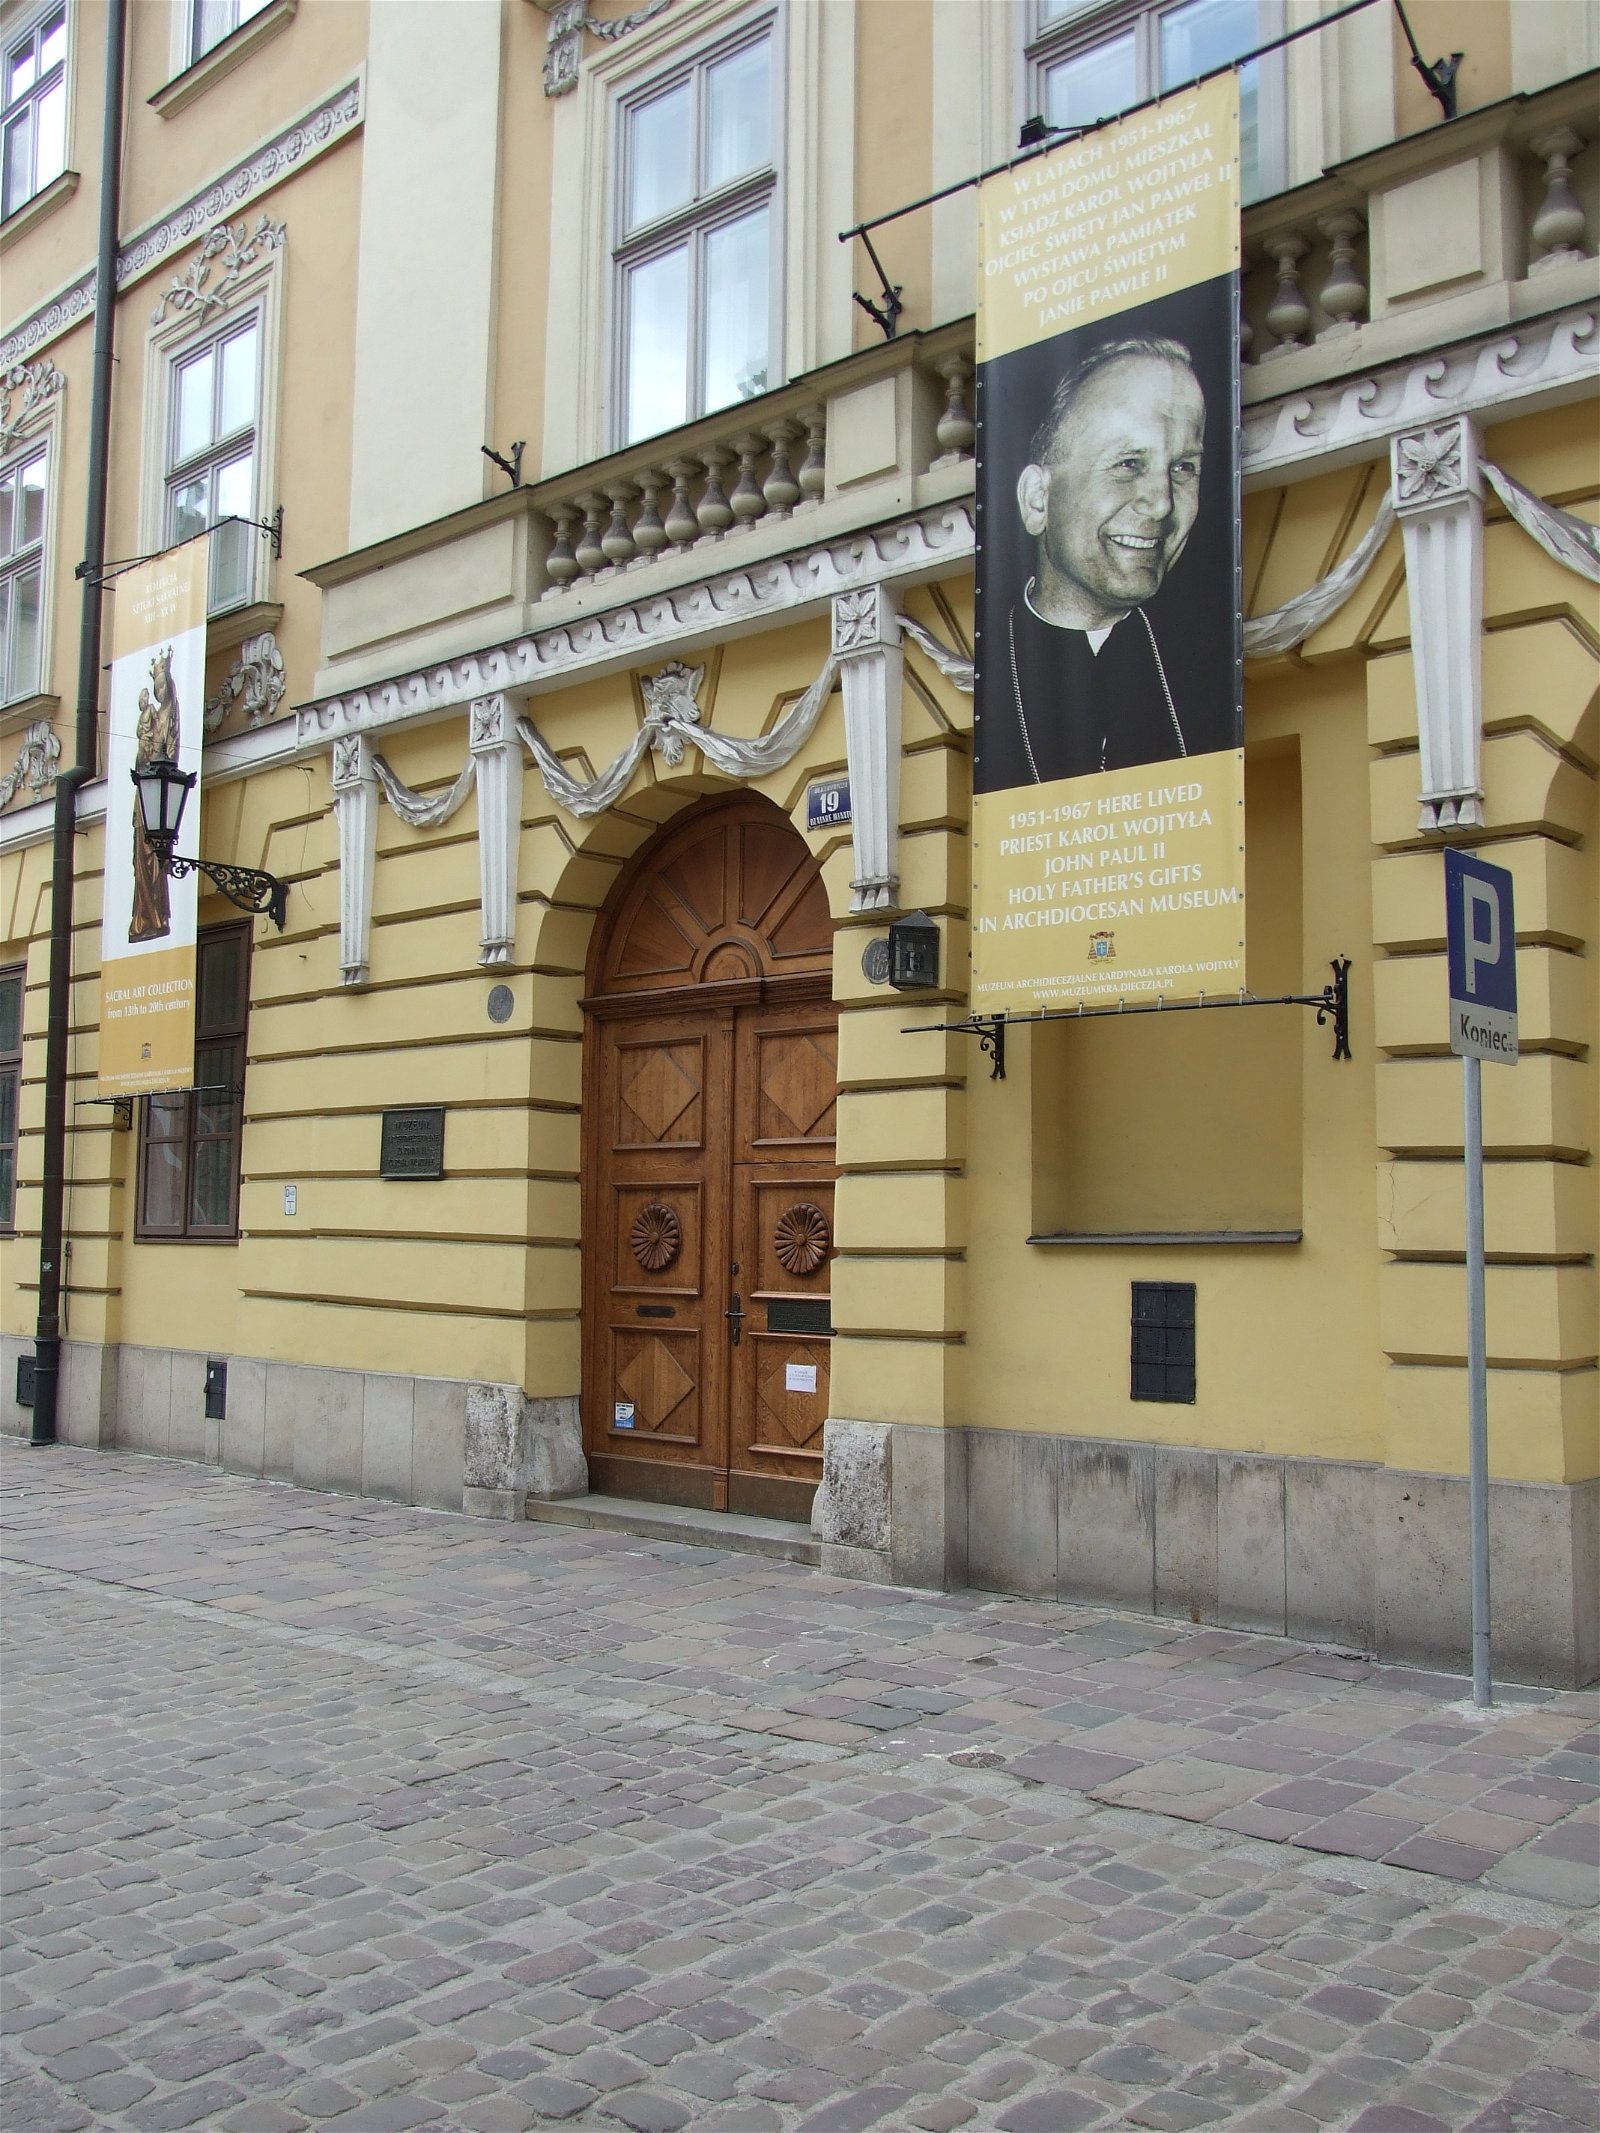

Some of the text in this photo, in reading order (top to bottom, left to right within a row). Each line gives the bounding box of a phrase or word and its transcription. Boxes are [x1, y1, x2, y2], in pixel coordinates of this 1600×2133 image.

[999, 121, 1214, 224] W TYM DOMU MIESZKAŁ
[1014, 103, 1198, 195] W LATACH 1951-1967
[985, 165, 1233, 277] OJCIEC ŚWIĘTY JAN PAWEŁ II
[1000, 149, 1214, 247] KSIĄDZ KAROL WOJTYŁA
[1014, 203, 1197, 287] WYSTAWA PAMIĄTEK
[1023, 232, 1186, 308] PO OJCU ŚWIĘTYM
[1039, 264, 1168, 328] JANIE PAWLE II
[820, 791, 839, 814] 19
[1009, 783, 1202, 830] 1951-1967 HERE LIVED
[1000, 809, 1212, 856] PRIEST KAROL WOJTYŁA
[1044, 842, 1165, 878] JOHN PAUL II
[1009, 863, 1201, 905] HOLY FATHER'S GIFTS
[979, 887, 1238, 933] IN ARCHDIOCESAN MUSEUM
[1463, 873, 1501, 995] P
[105, 979, 193, 1002] SACRAL ART COLLECTION
[977, 981, 1014, 992] MUZEUM
[1016, 973, 1097, 989] ARCHIDIECEZJALNE
[1156, 964, 1193, 976] KAROLA
[1196, 960, 1240, 972] WOJTYŁY
[125, 1004, 138, 1016] 13th
[140, 1004, 147, 1014] to
[165, 999, 190, 1011] century
[1460, 1013, 1508, 1052] Koniec
